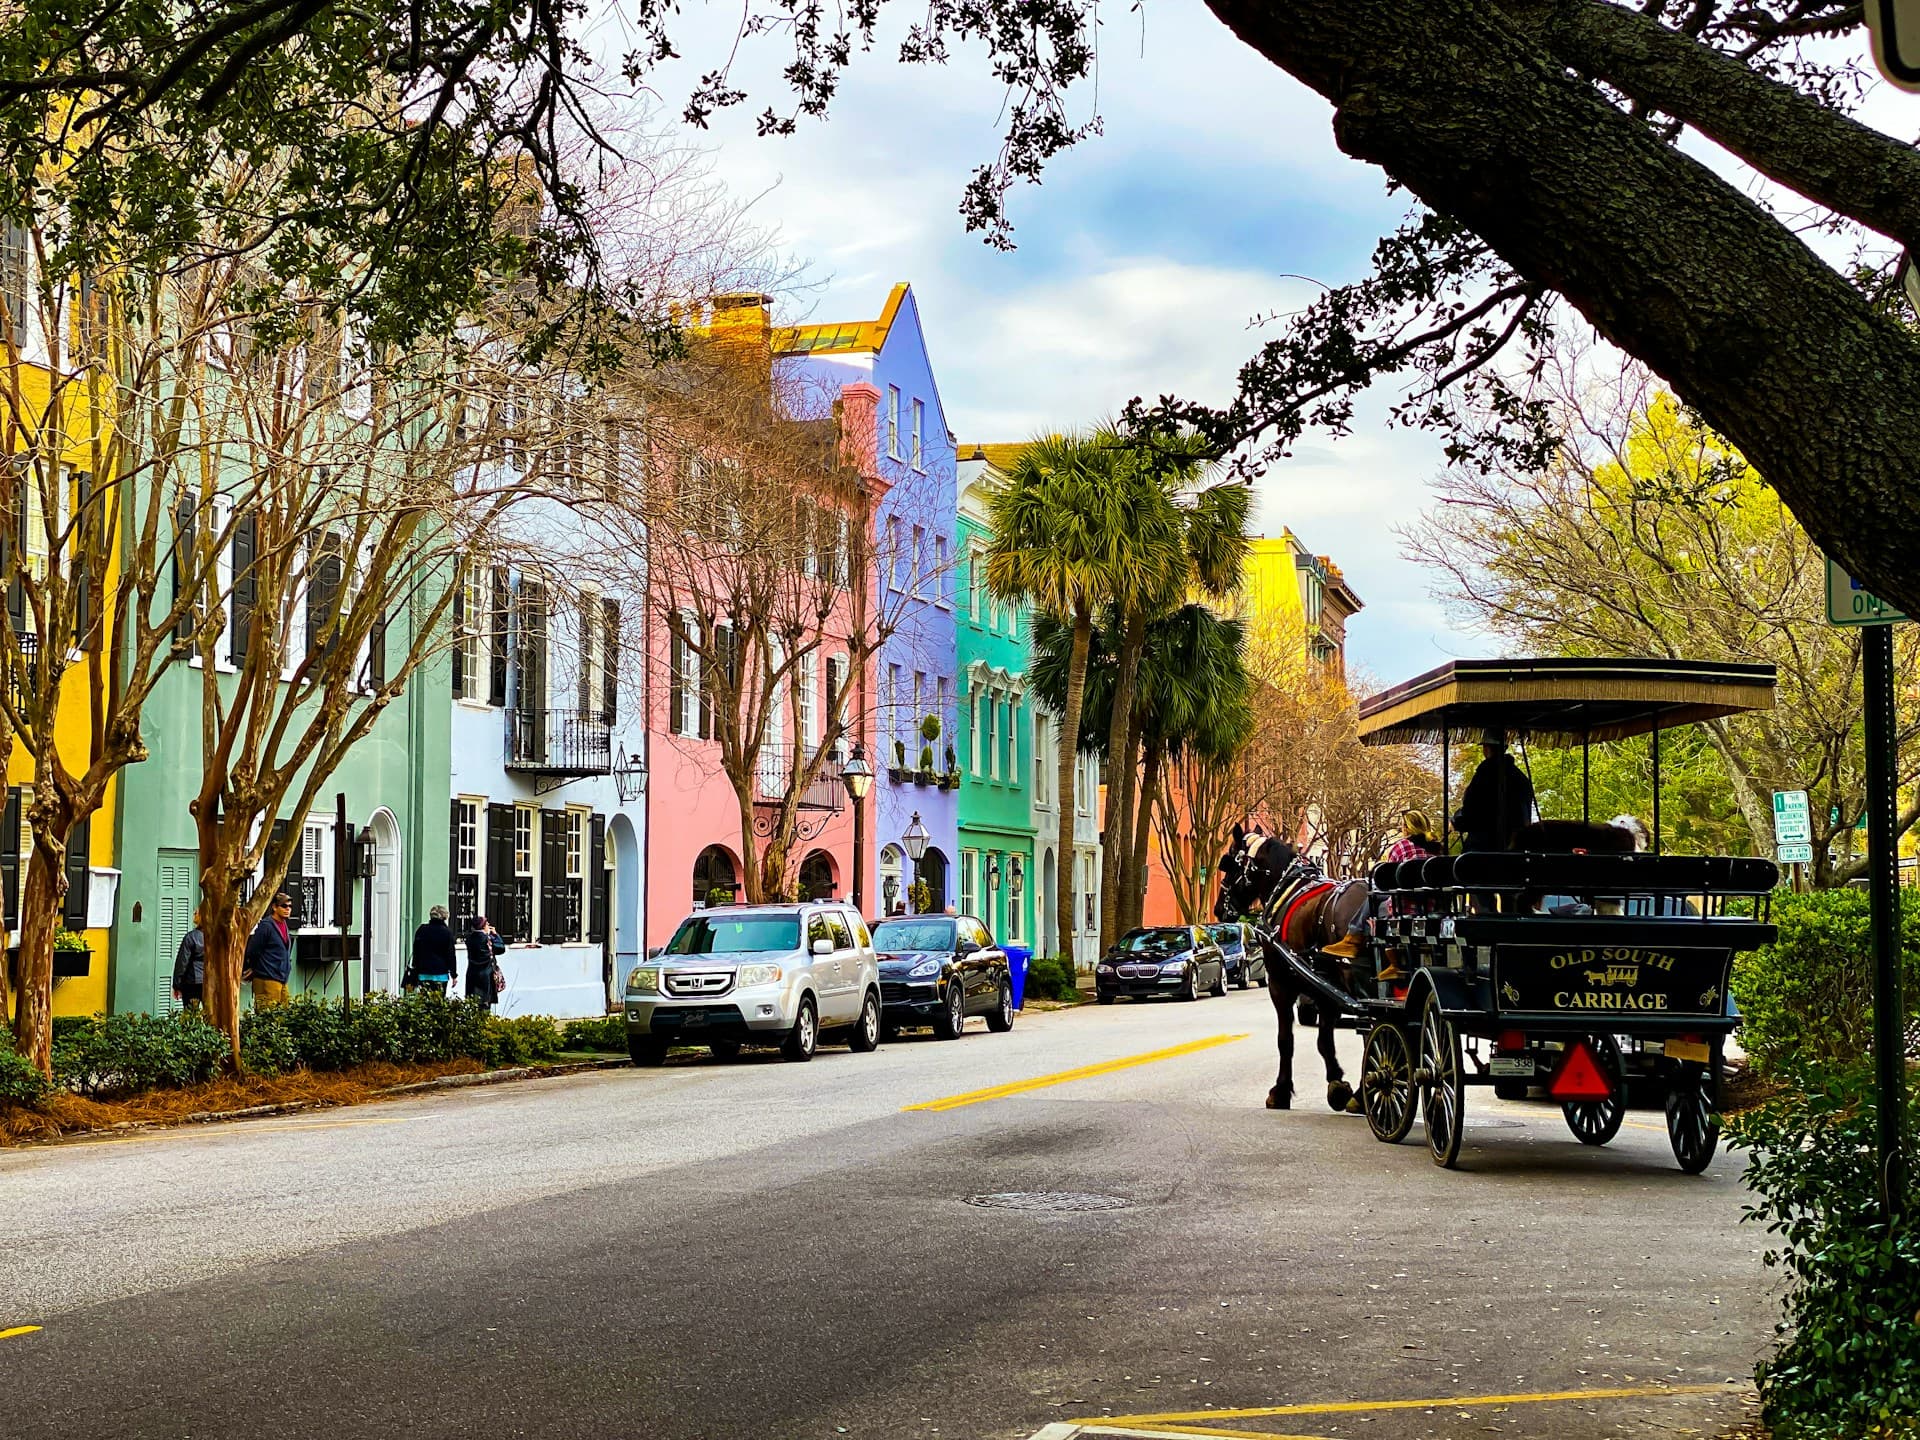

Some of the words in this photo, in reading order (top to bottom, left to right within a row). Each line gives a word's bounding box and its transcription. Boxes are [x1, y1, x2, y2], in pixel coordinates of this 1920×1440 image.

[1853, 594, 1897, 615] ONL
[1785, 802, 1805, 810] PARKING
[1779, 811, 1804, 820] RESIDENTIAL
[1779, 825, 1800, 833] DISTRICT
[1550, 949, 1596, 969] OLD
[1601, 947, 1676, 971] SOUTH
[1554, 991, 1668, 1010] CARRIAGE
